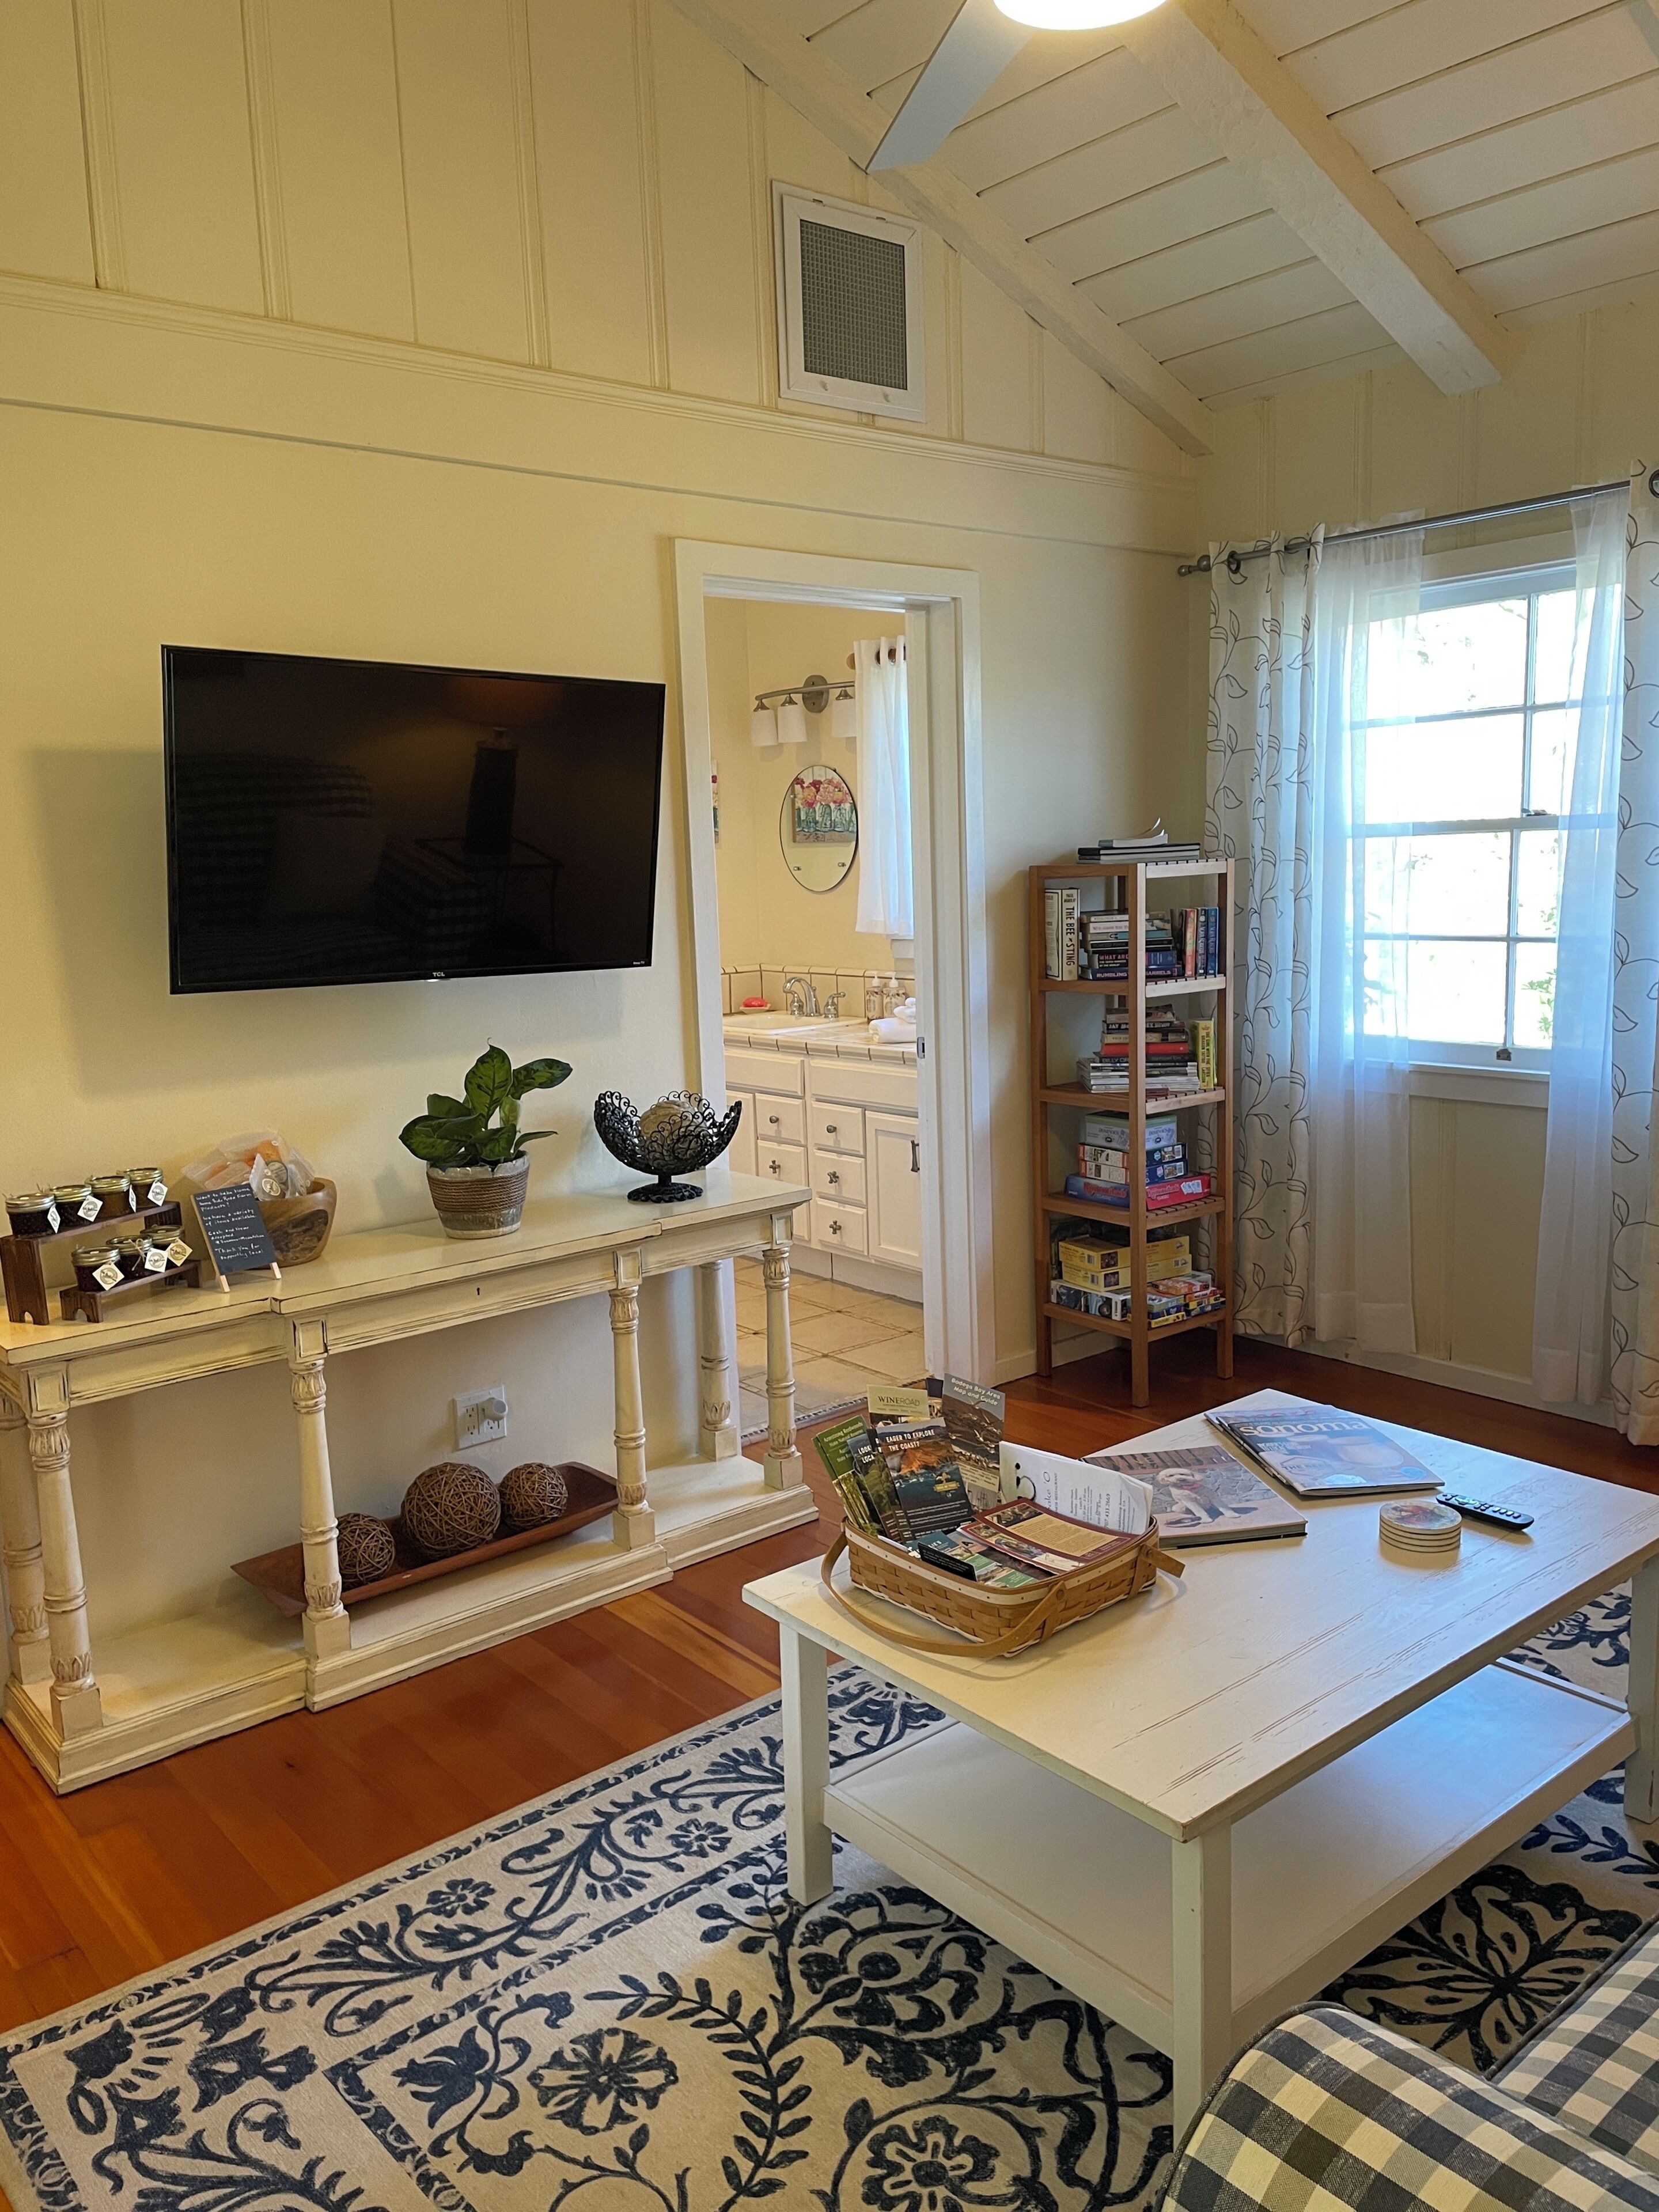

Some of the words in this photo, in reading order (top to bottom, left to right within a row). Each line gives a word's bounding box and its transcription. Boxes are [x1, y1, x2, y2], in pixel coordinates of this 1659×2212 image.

[1066, 906, 1074, 920] THE
[1066, 923, 1074, 936] BEE
[1066, 943, 1075, 966] STING
[951, 1377, 973, 1389] Bodega
[974, 1386, 986, 1395] Bay
[986, 1391, 1001, 1399] Area
[953, 1386, 967, 1395] Map
[980, 1396, 998, 1406] Guide
[1239, 1421, 1372, 1436] sonoma
[886, 1434, 903, 1443] EAGER
[912, 1429, 935, 1438] EXPLORE
[900, 1441, 920, 1449] COAST?
